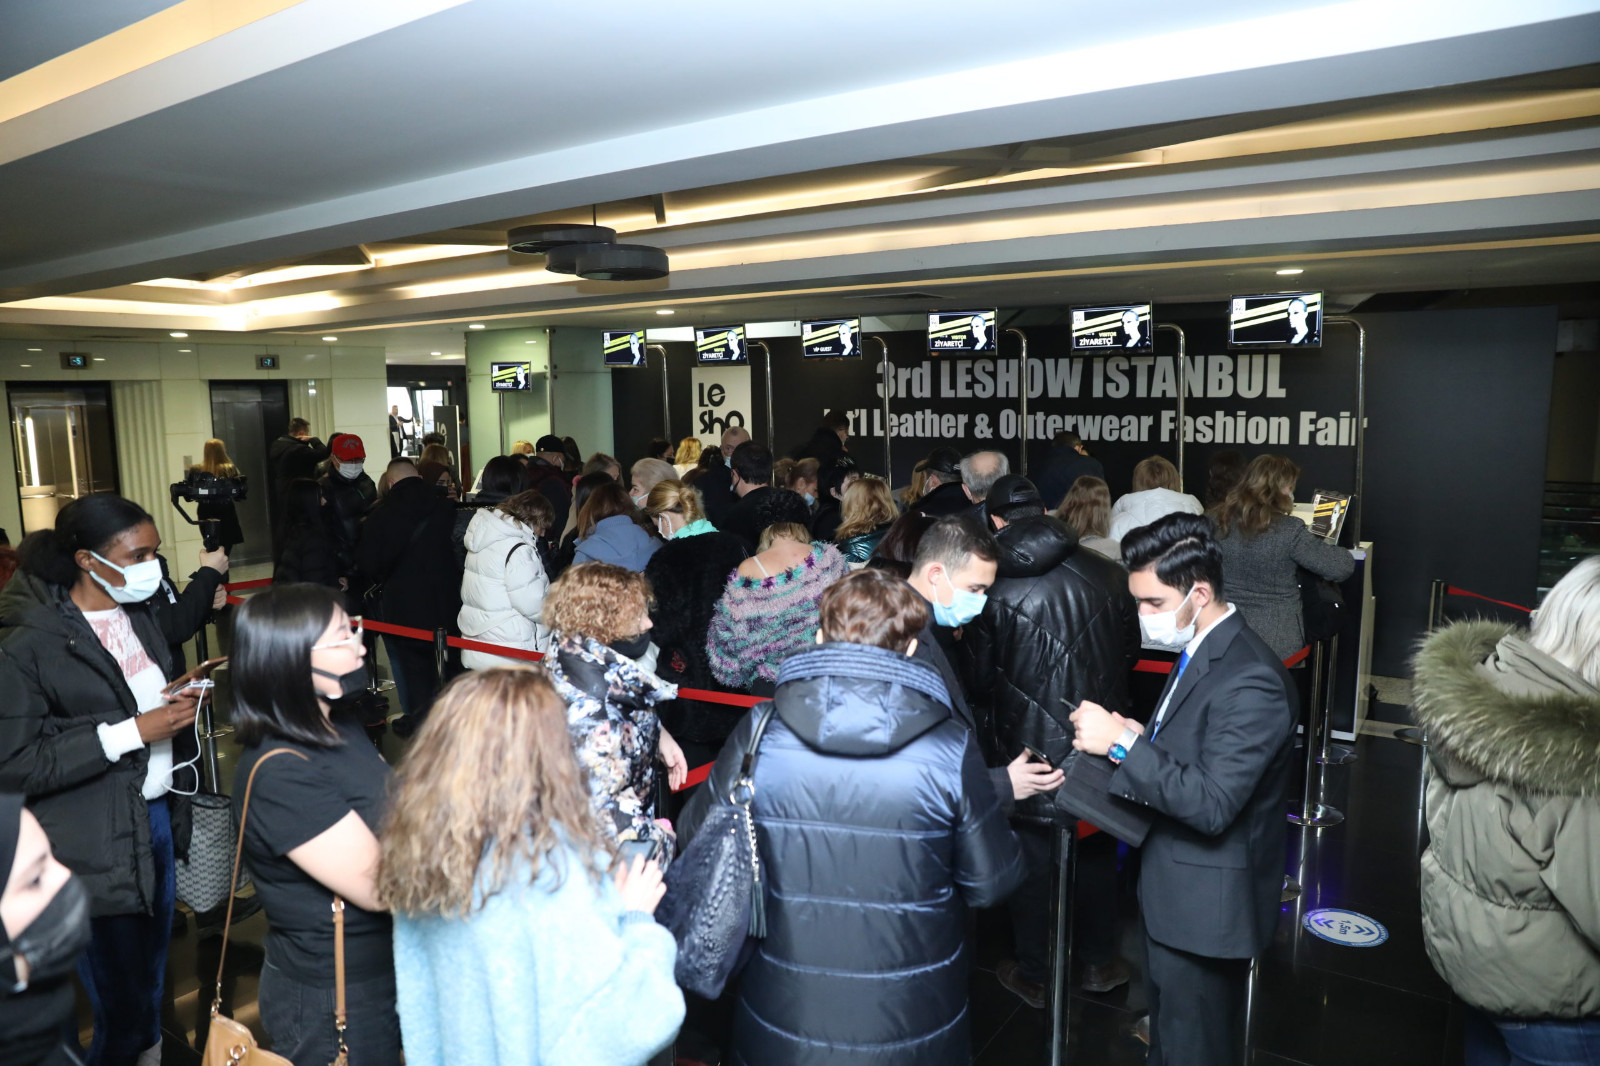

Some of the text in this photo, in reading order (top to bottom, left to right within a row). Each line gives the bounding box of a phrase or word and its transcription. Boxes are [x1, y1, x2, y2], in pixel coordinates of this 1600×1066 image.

[698, 382, 726, 408] Le
[876, 360, 932, 399] 3rd
[940, 356, 1084, 399] LESHOW
[873, 408, 969, 439] Leather
[973, 412, 994, 440] &
[999, 408, 1154, 442] Outerwear
[1159, 410, 1291, 445] Fashion
